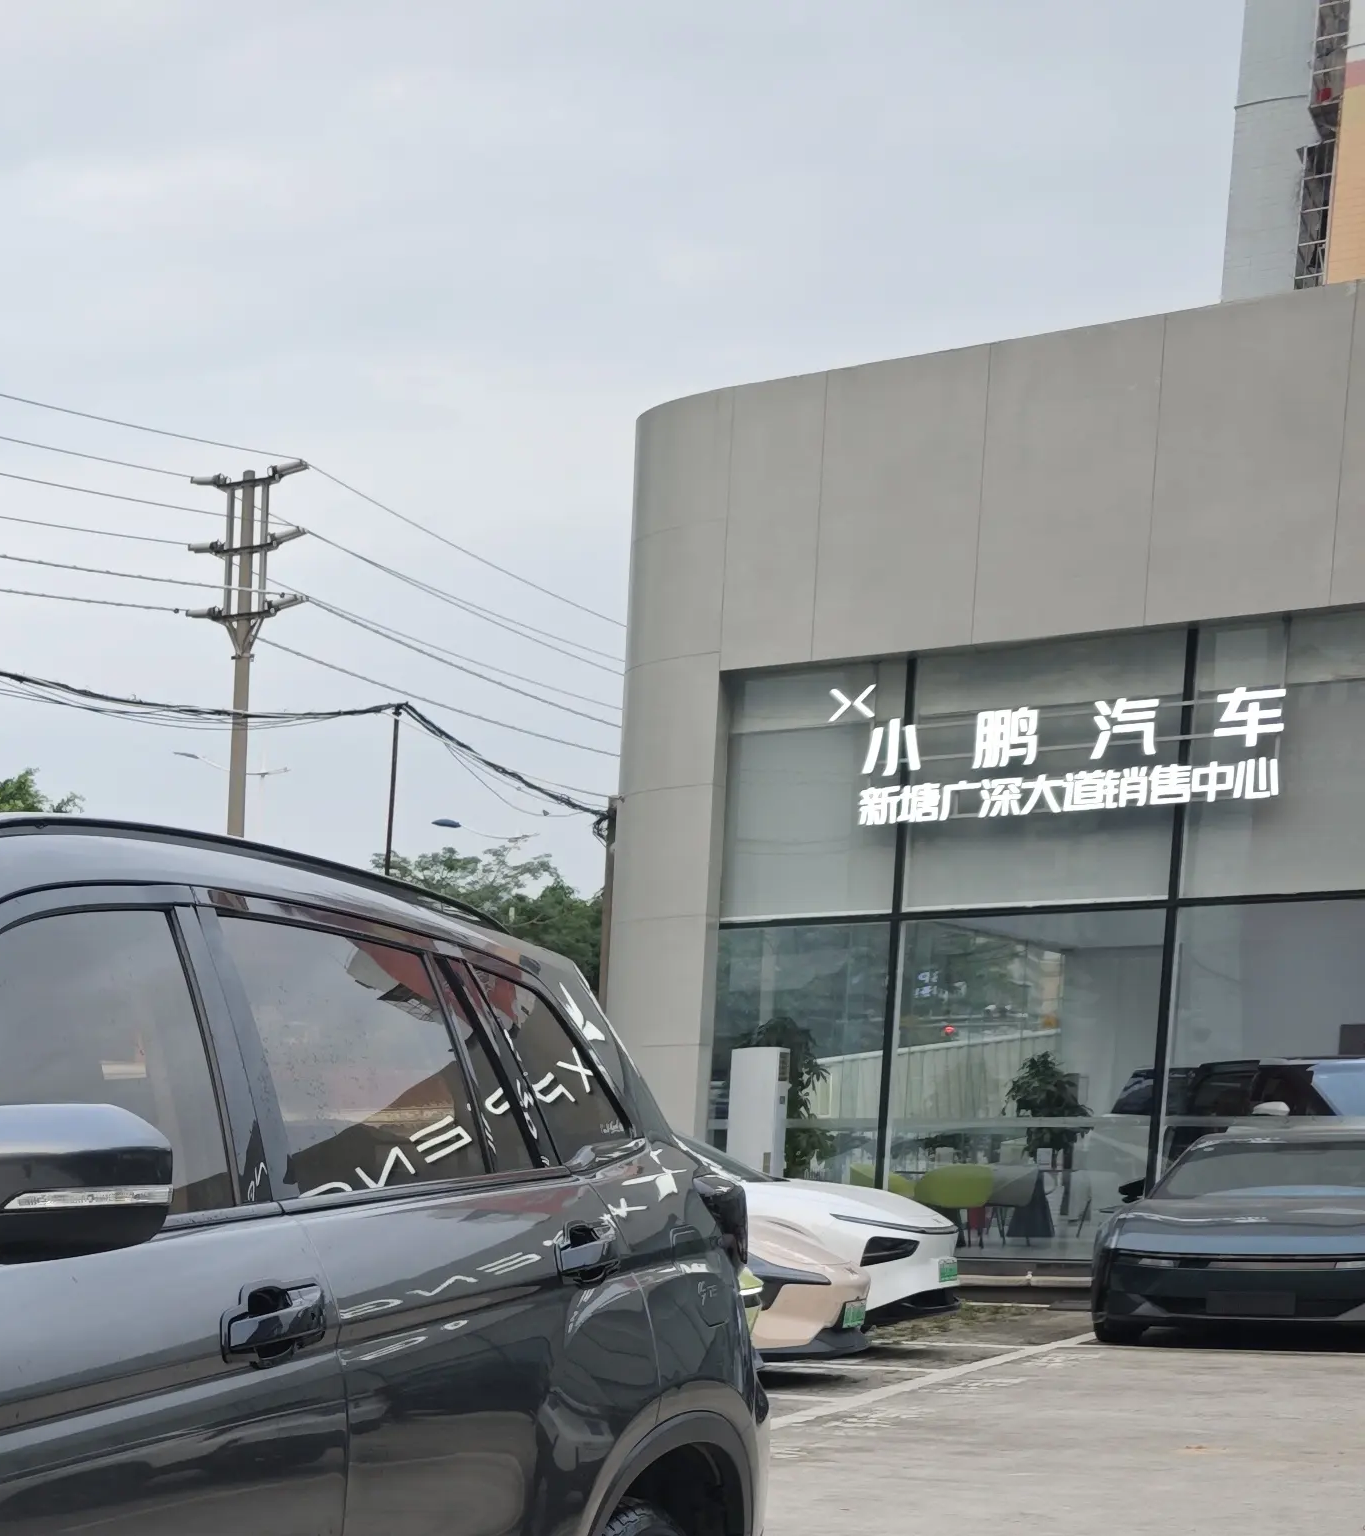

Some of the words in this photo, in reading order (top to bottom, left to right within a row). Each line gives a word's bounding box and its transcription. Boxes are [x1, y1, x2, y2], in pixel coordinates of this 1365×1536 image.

[862, 686, 1287, 777] 小鹏汽车
[858, 756, 1279, 826] 新塘广深大道销售中心
